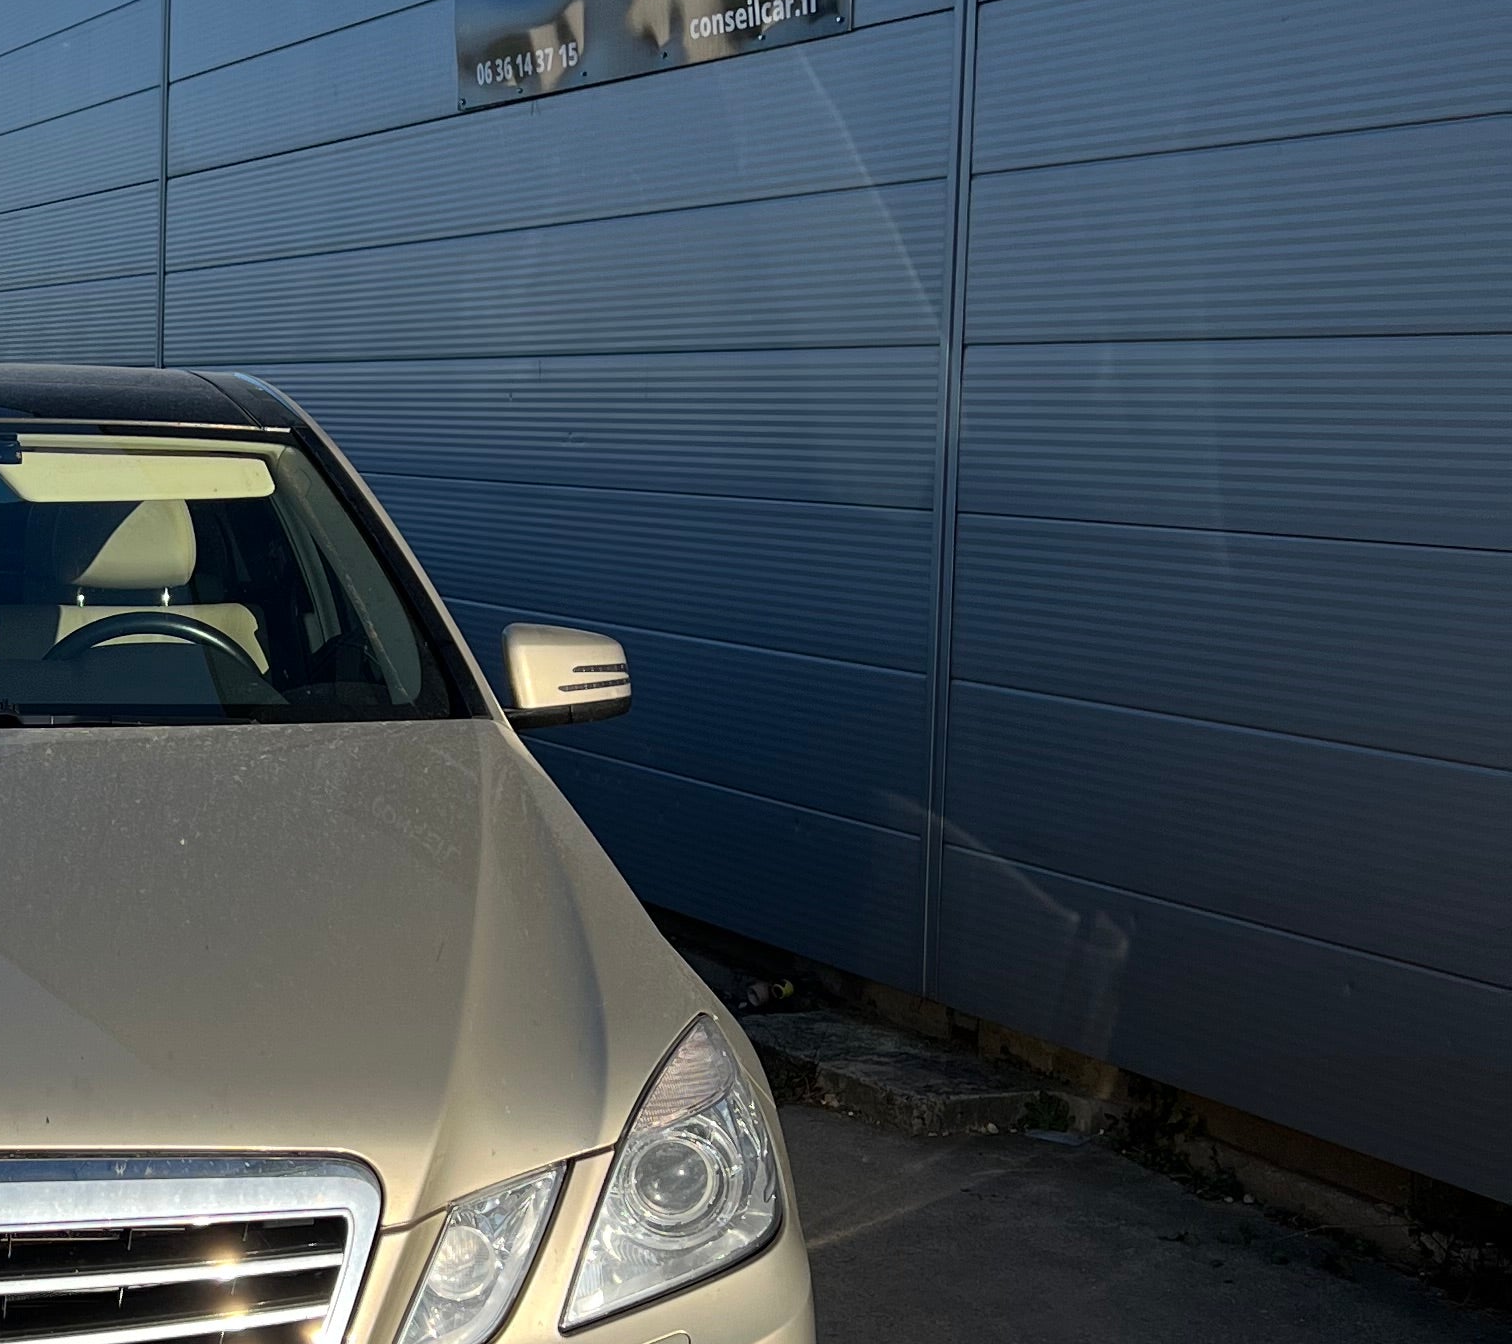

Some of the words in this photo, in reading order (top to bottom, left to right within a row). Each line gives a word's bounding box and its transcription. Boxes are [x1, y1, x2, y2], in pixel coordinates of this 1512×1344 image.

[476, 60, 493, 86] 06
[495, 56, 513, 82] 36
[516, 51, 533, 77] 14
[535, 47, 554, 73] 37
[558, 42, 578, 68] 15
